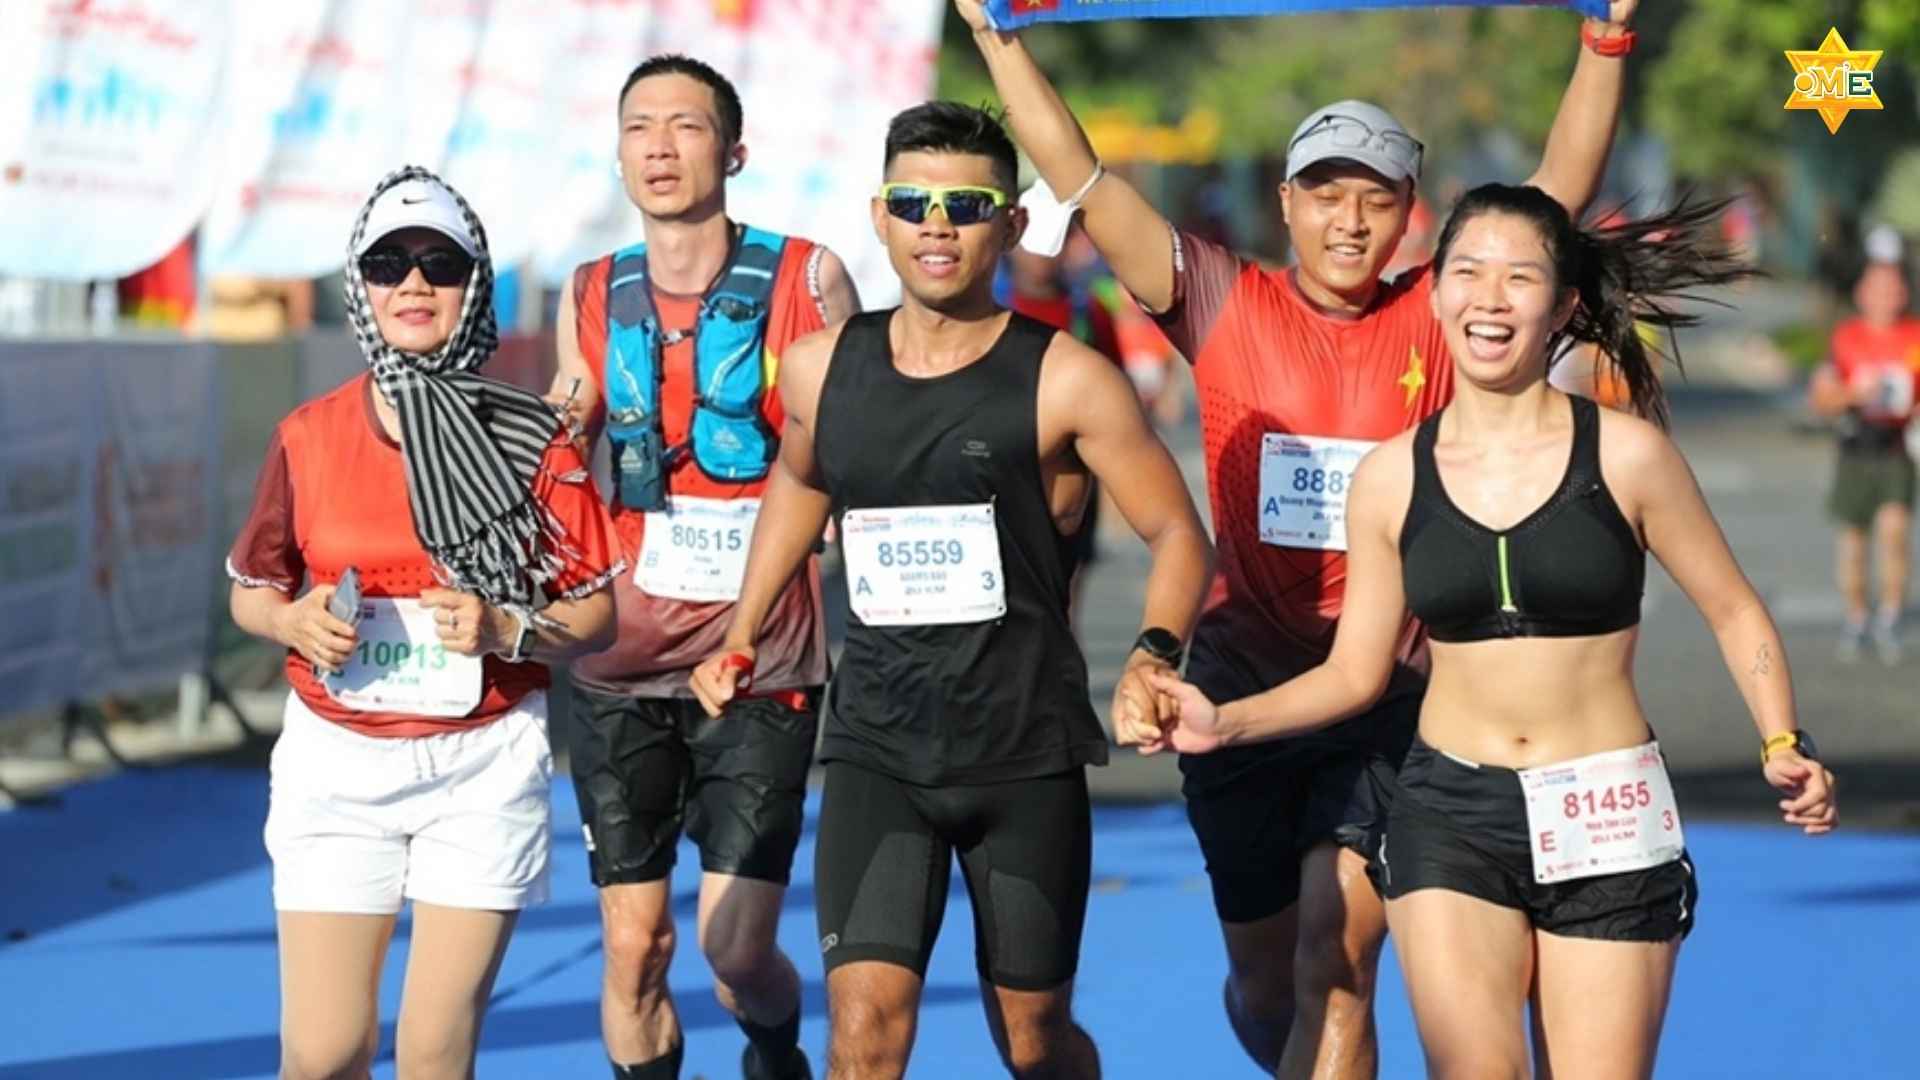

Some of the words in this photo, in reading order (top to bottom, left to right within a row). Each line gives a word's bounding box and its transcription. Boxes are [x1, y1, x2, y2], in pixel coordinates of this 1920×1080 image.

[1292, 467, 1354, 495] 888
[1264, 496, 1280, 516] A
[671, 523, 743, 552] 80515
[877, 538, 964, 567] 85559
[855, 575, 873, 596] A
[981, 570, 996, 591] 3
[356, 639, 450, 670] 10013
[1563, 780, 1651, 819] 81455
[1662, 809, 1674, 831] 3
[1539, 830, 1557, 853] E
